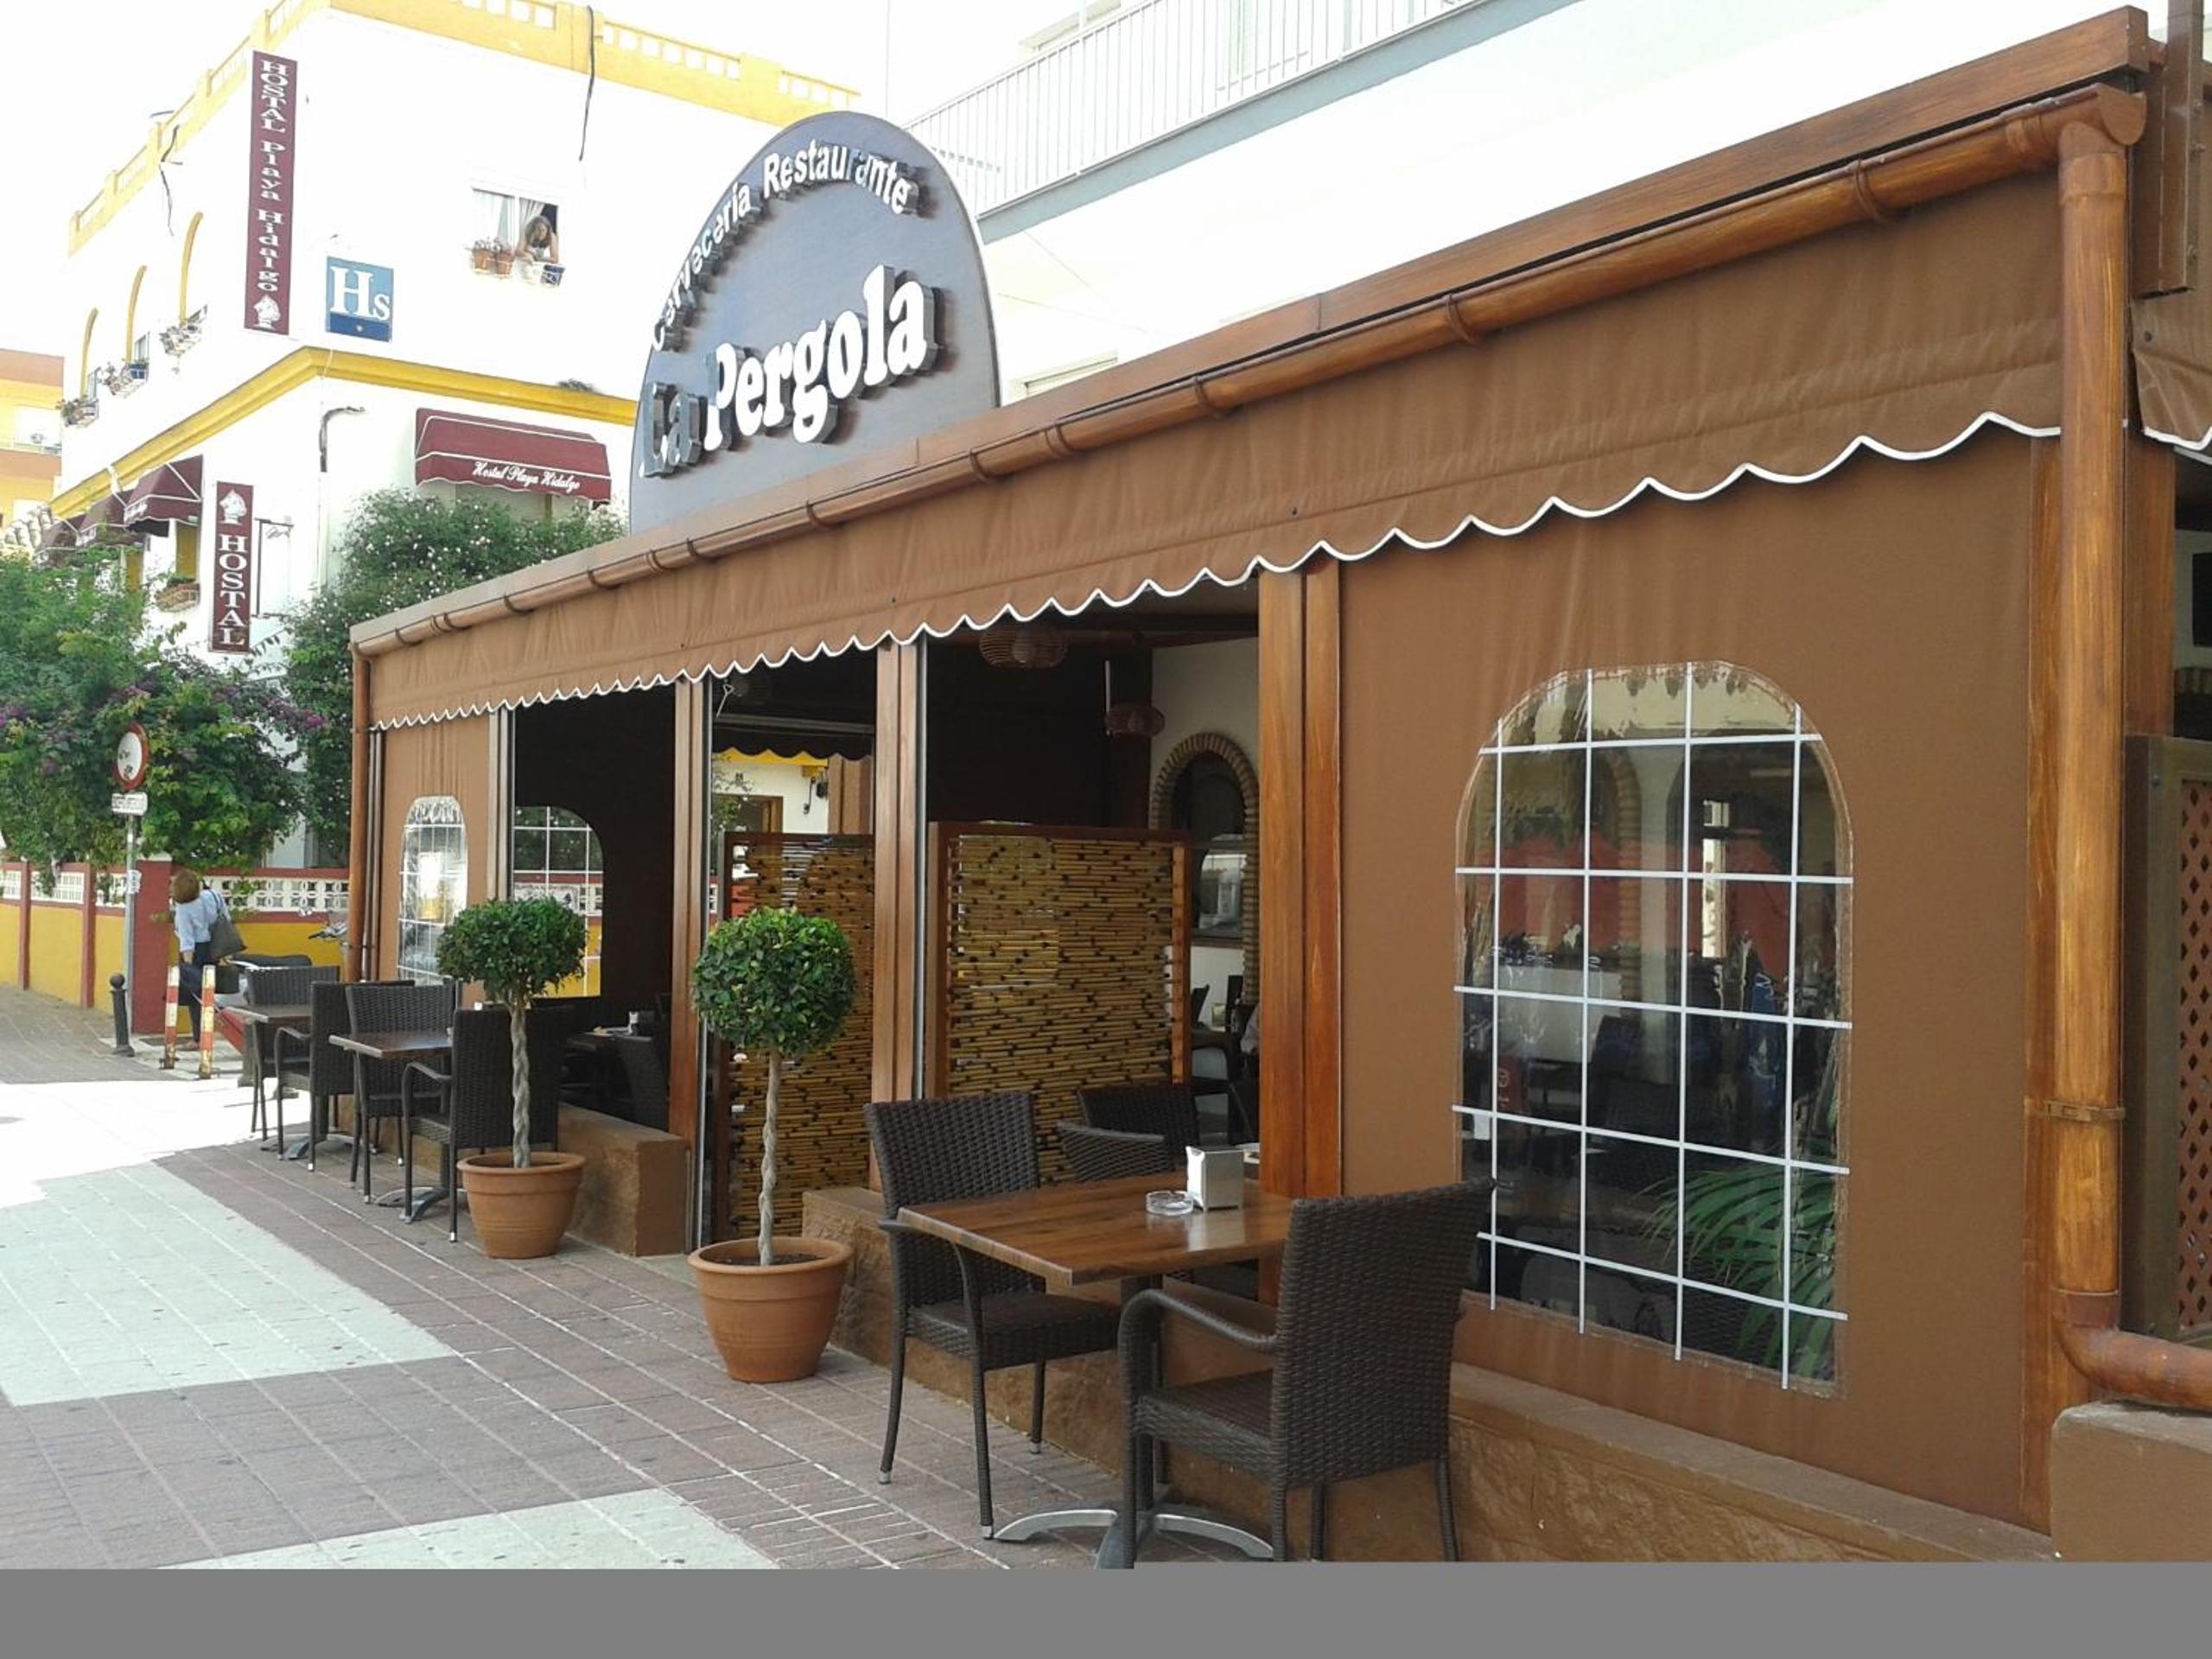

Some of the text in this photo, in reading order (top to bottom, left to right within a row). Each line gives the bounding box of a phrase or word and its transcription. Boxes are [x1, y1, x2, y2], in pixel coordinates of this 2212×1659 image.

[257, 60, 288, 291] HOSTAL Playa Hidalgo
[763, 138, 913, 215] Restaurante
[329, 266, 391, 321] Hs
[639, 264, 929, 479] La Pergola
[472, 461, 581, 493] Hostal Playa Hidalgo
[218, 534, 249, 646] HOSTAL
